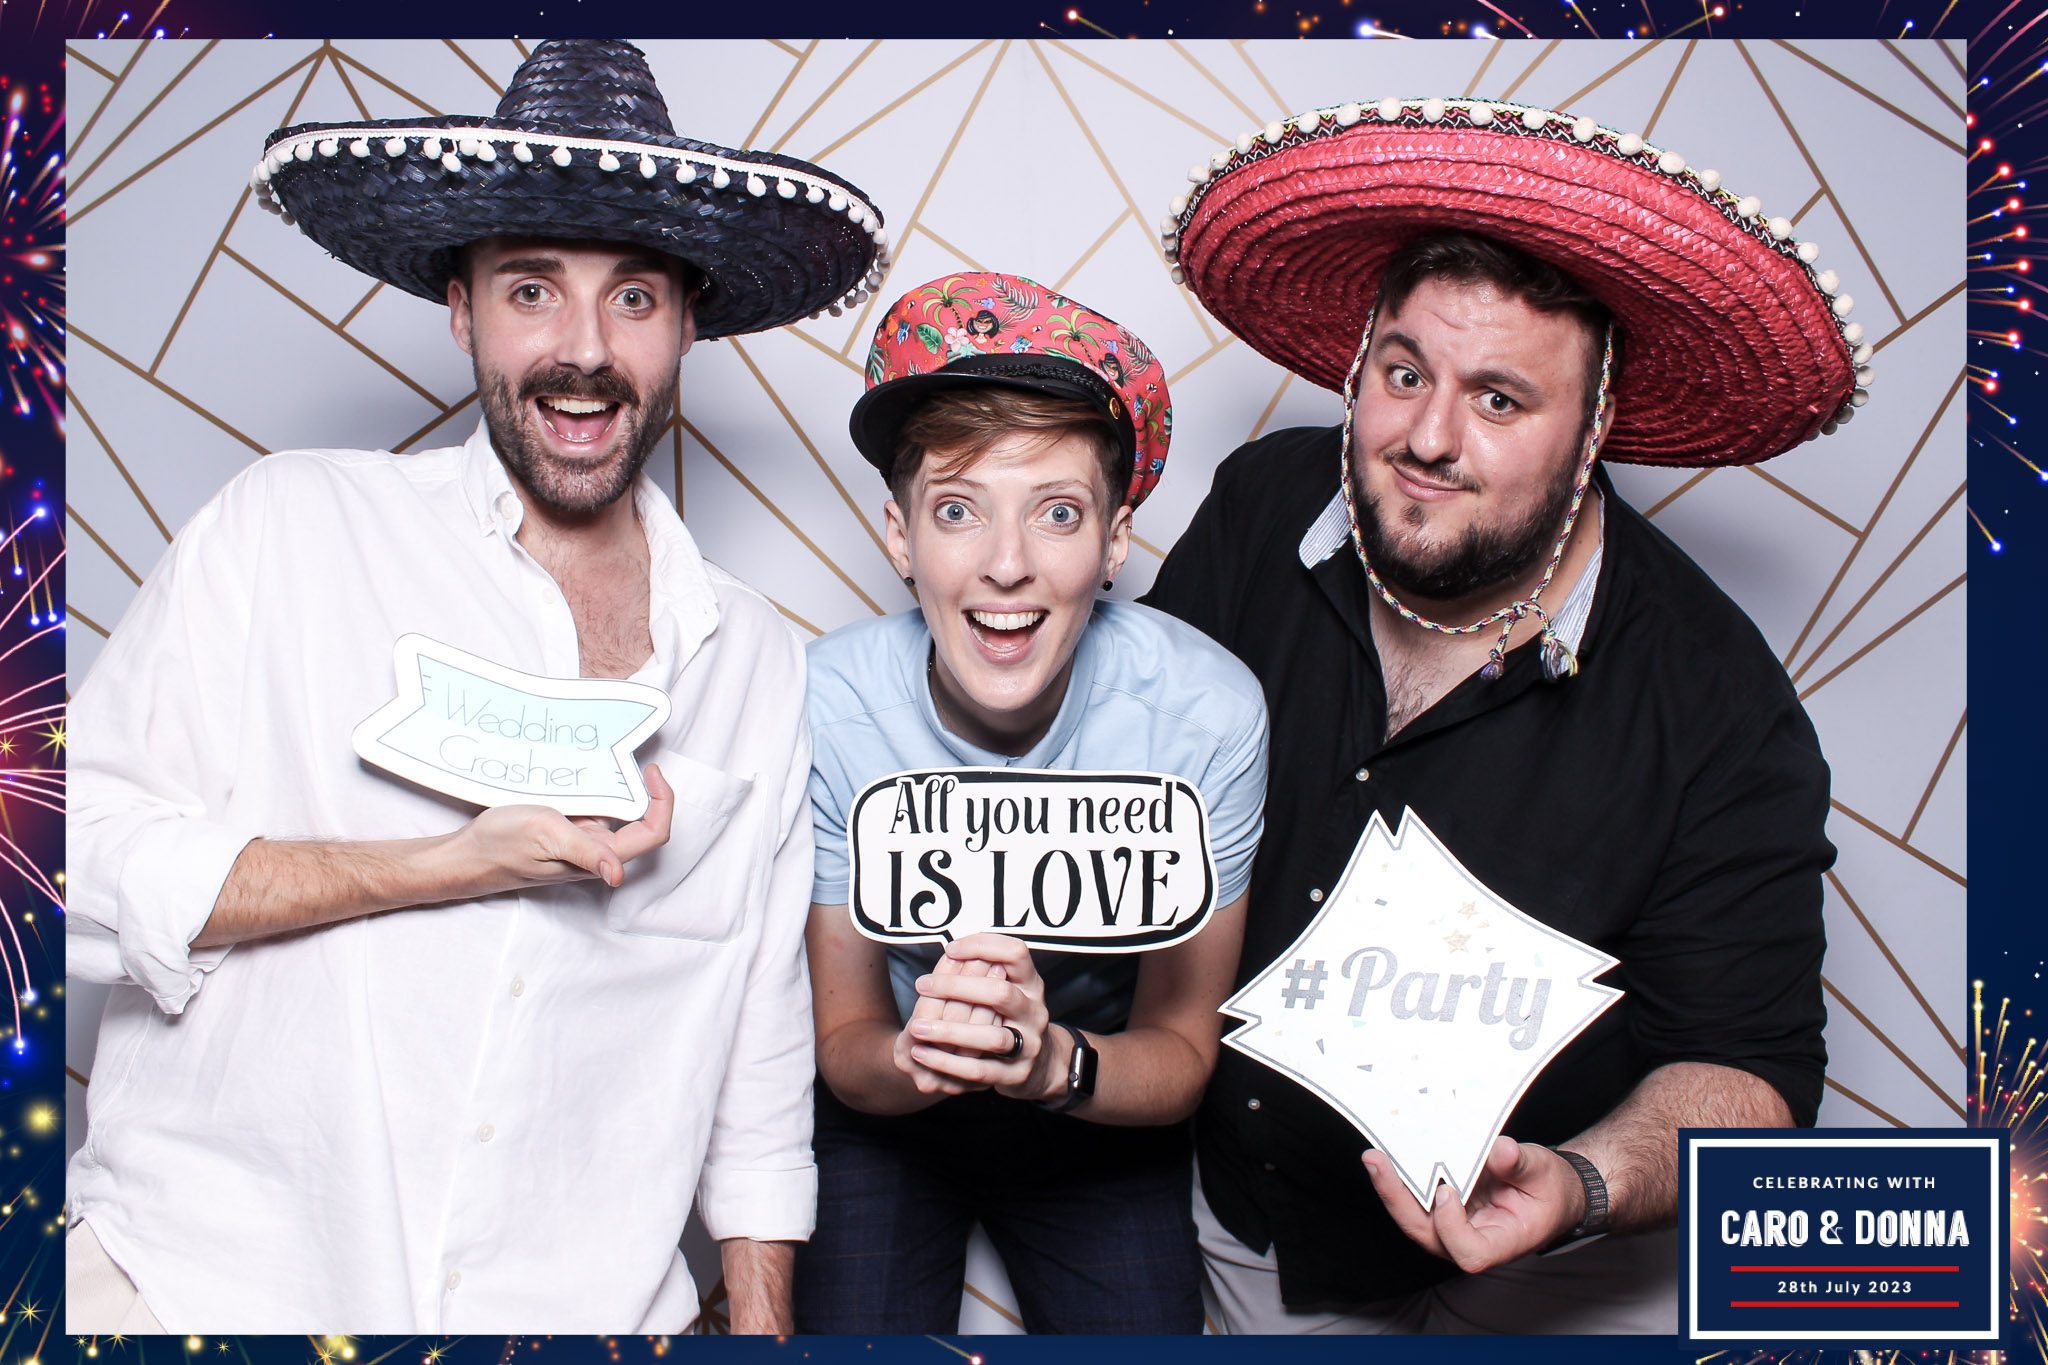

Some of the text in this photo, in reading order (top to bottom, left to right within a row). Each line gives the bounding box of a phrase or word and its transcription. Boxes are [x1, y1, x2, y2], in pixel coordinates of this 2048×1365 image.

[448, 682, 599, 751] Wedding
[439, 735, 588, 786] Crasher
[889, 778, 1173, 852] All you need
[888, 846, 1180, 928] IS LOVE
[1281, 946, 1552, 1051] # Party
